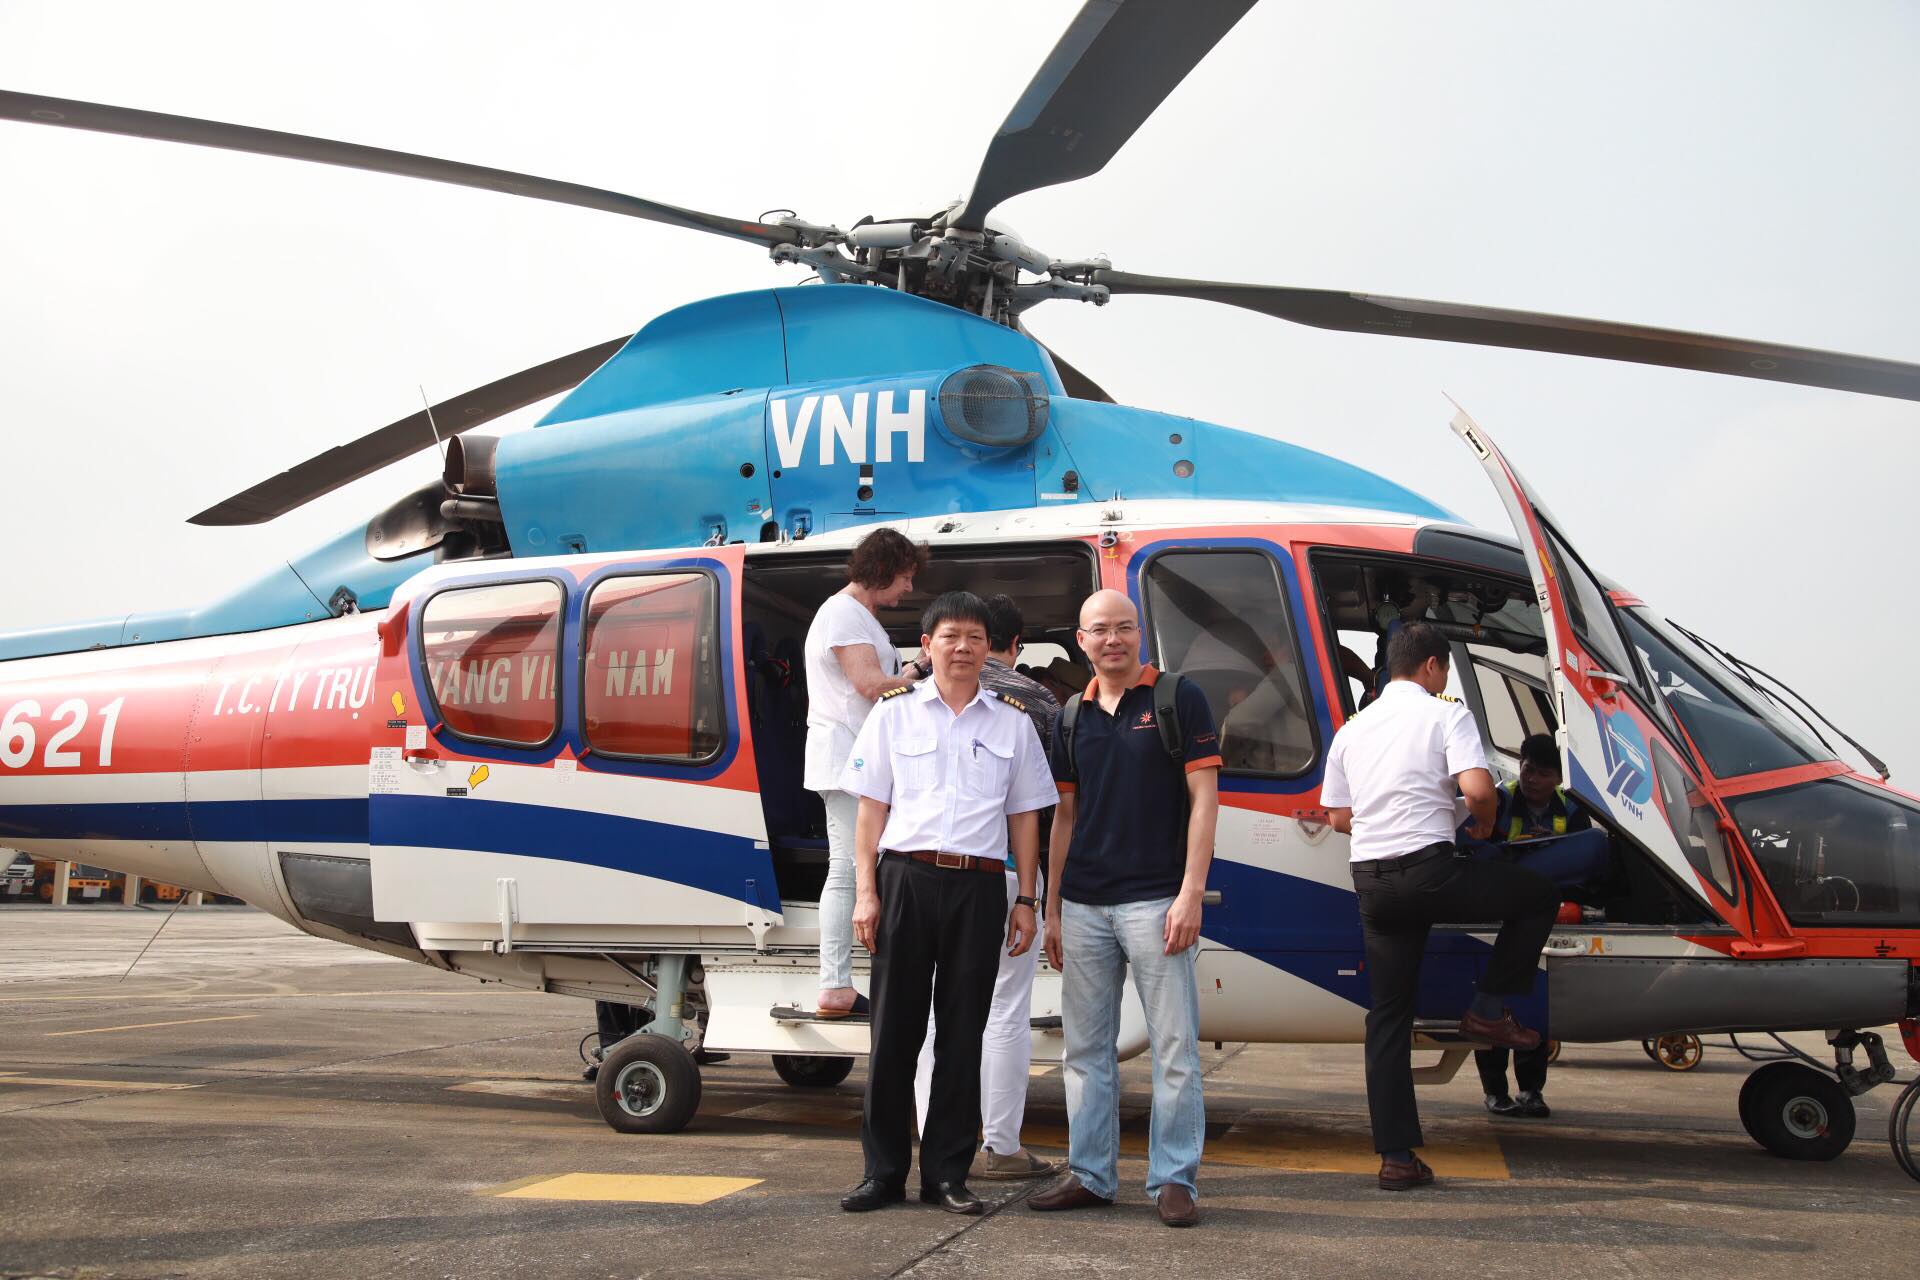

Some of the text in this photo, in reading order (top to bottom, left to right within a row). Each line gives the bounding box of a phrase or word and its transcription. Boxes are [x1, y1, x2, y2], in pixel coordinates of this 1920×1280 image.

[770, 389, 926, 469] VNH
[605, 648, 675, 697] NAM
[0, 696, 125, 769] 621
[1621, 796, 1643, 821] VNH
